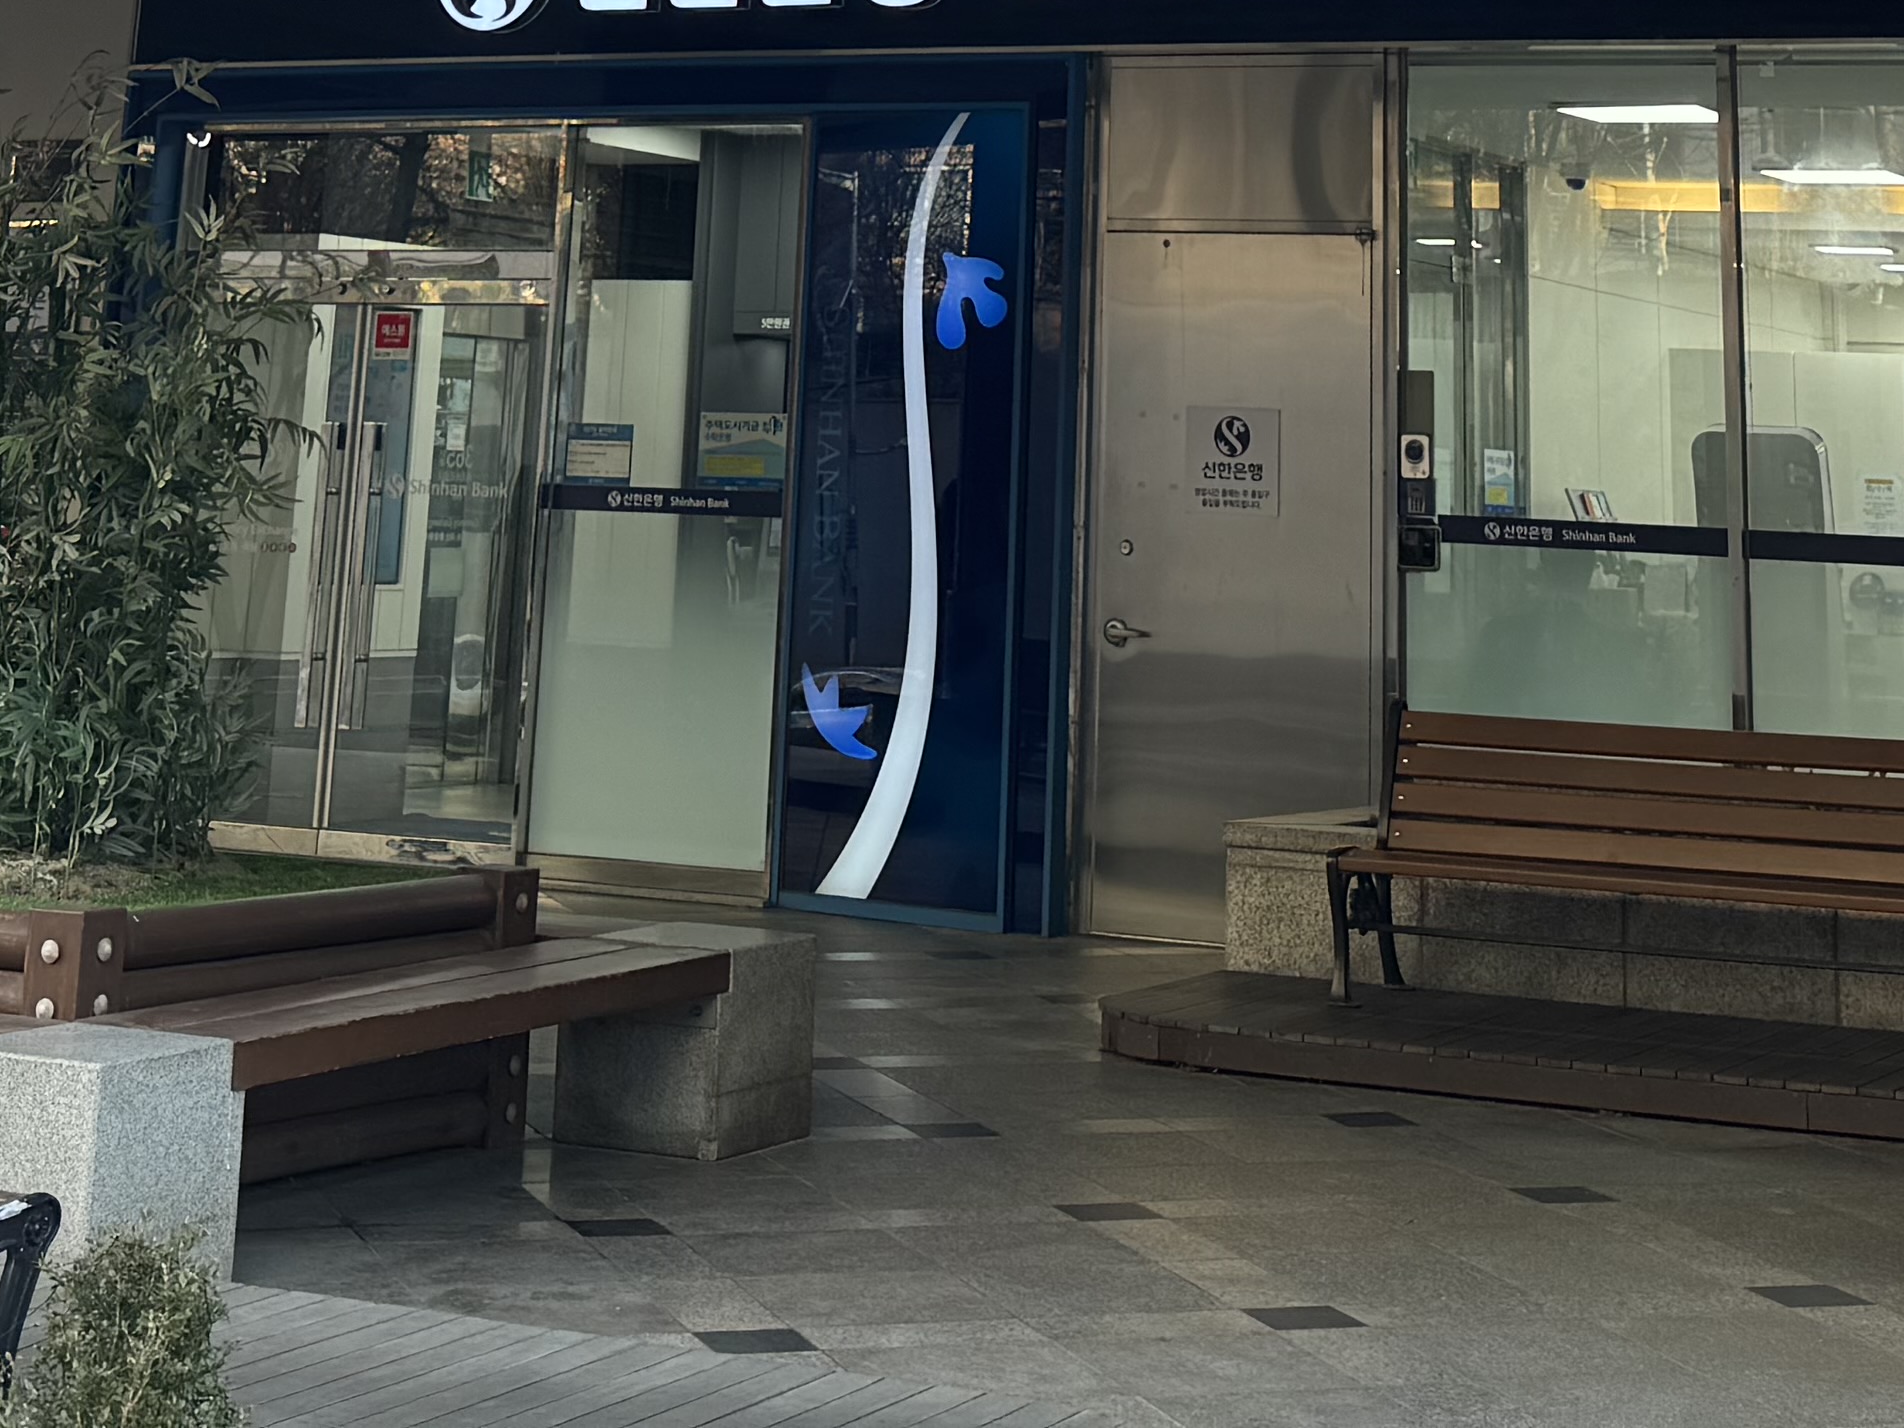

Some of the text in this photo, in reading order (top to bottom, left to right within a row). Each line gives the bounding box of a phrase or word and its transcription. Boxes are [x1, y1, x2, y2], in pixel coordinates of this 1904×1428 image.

[1202, 461, 1264, 482] 신한은행
[471, 481, 509, 500] Bank
[623, 493, 730, 509] 신한은행 Shinhan Bank
[1503, 524, 1636, 545] 신한은행 Shinhan Bank
